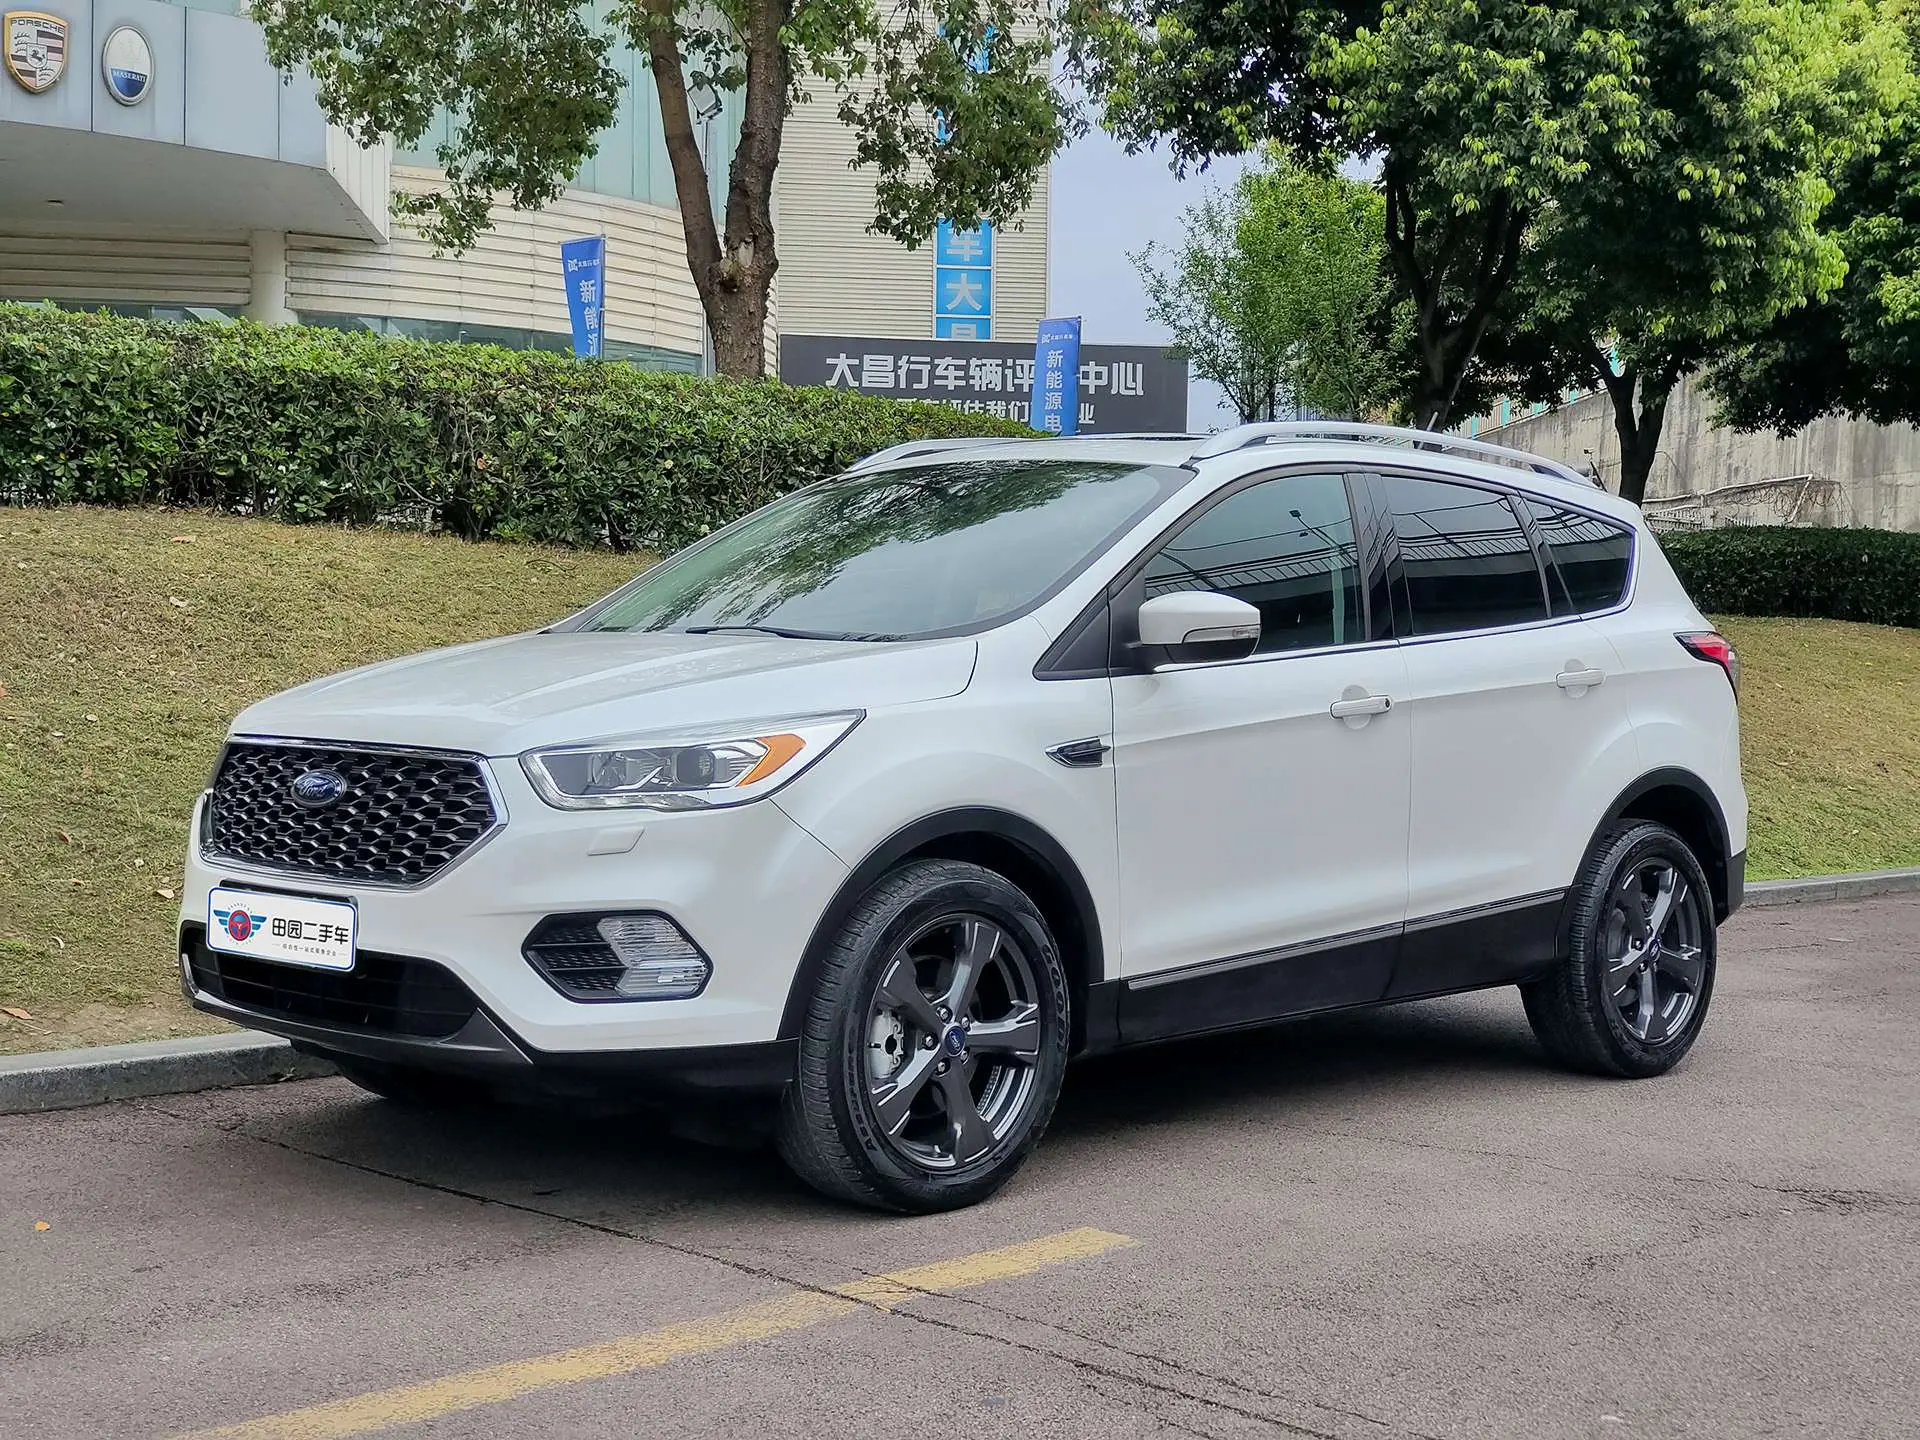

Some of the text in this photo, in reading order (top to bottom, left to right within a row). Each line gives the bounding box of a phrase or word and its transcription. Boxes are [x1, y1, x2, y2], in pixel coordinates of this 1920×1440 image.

[10, 19, 65, 35] PORSCHE
[112, 69, 147, 83] MASERATI
[825, 353, 1144, 396] 大昌行车辆评中心
[296, 775, 329, 797] Ford
[272, 917, 349, 945] 田园二手车
